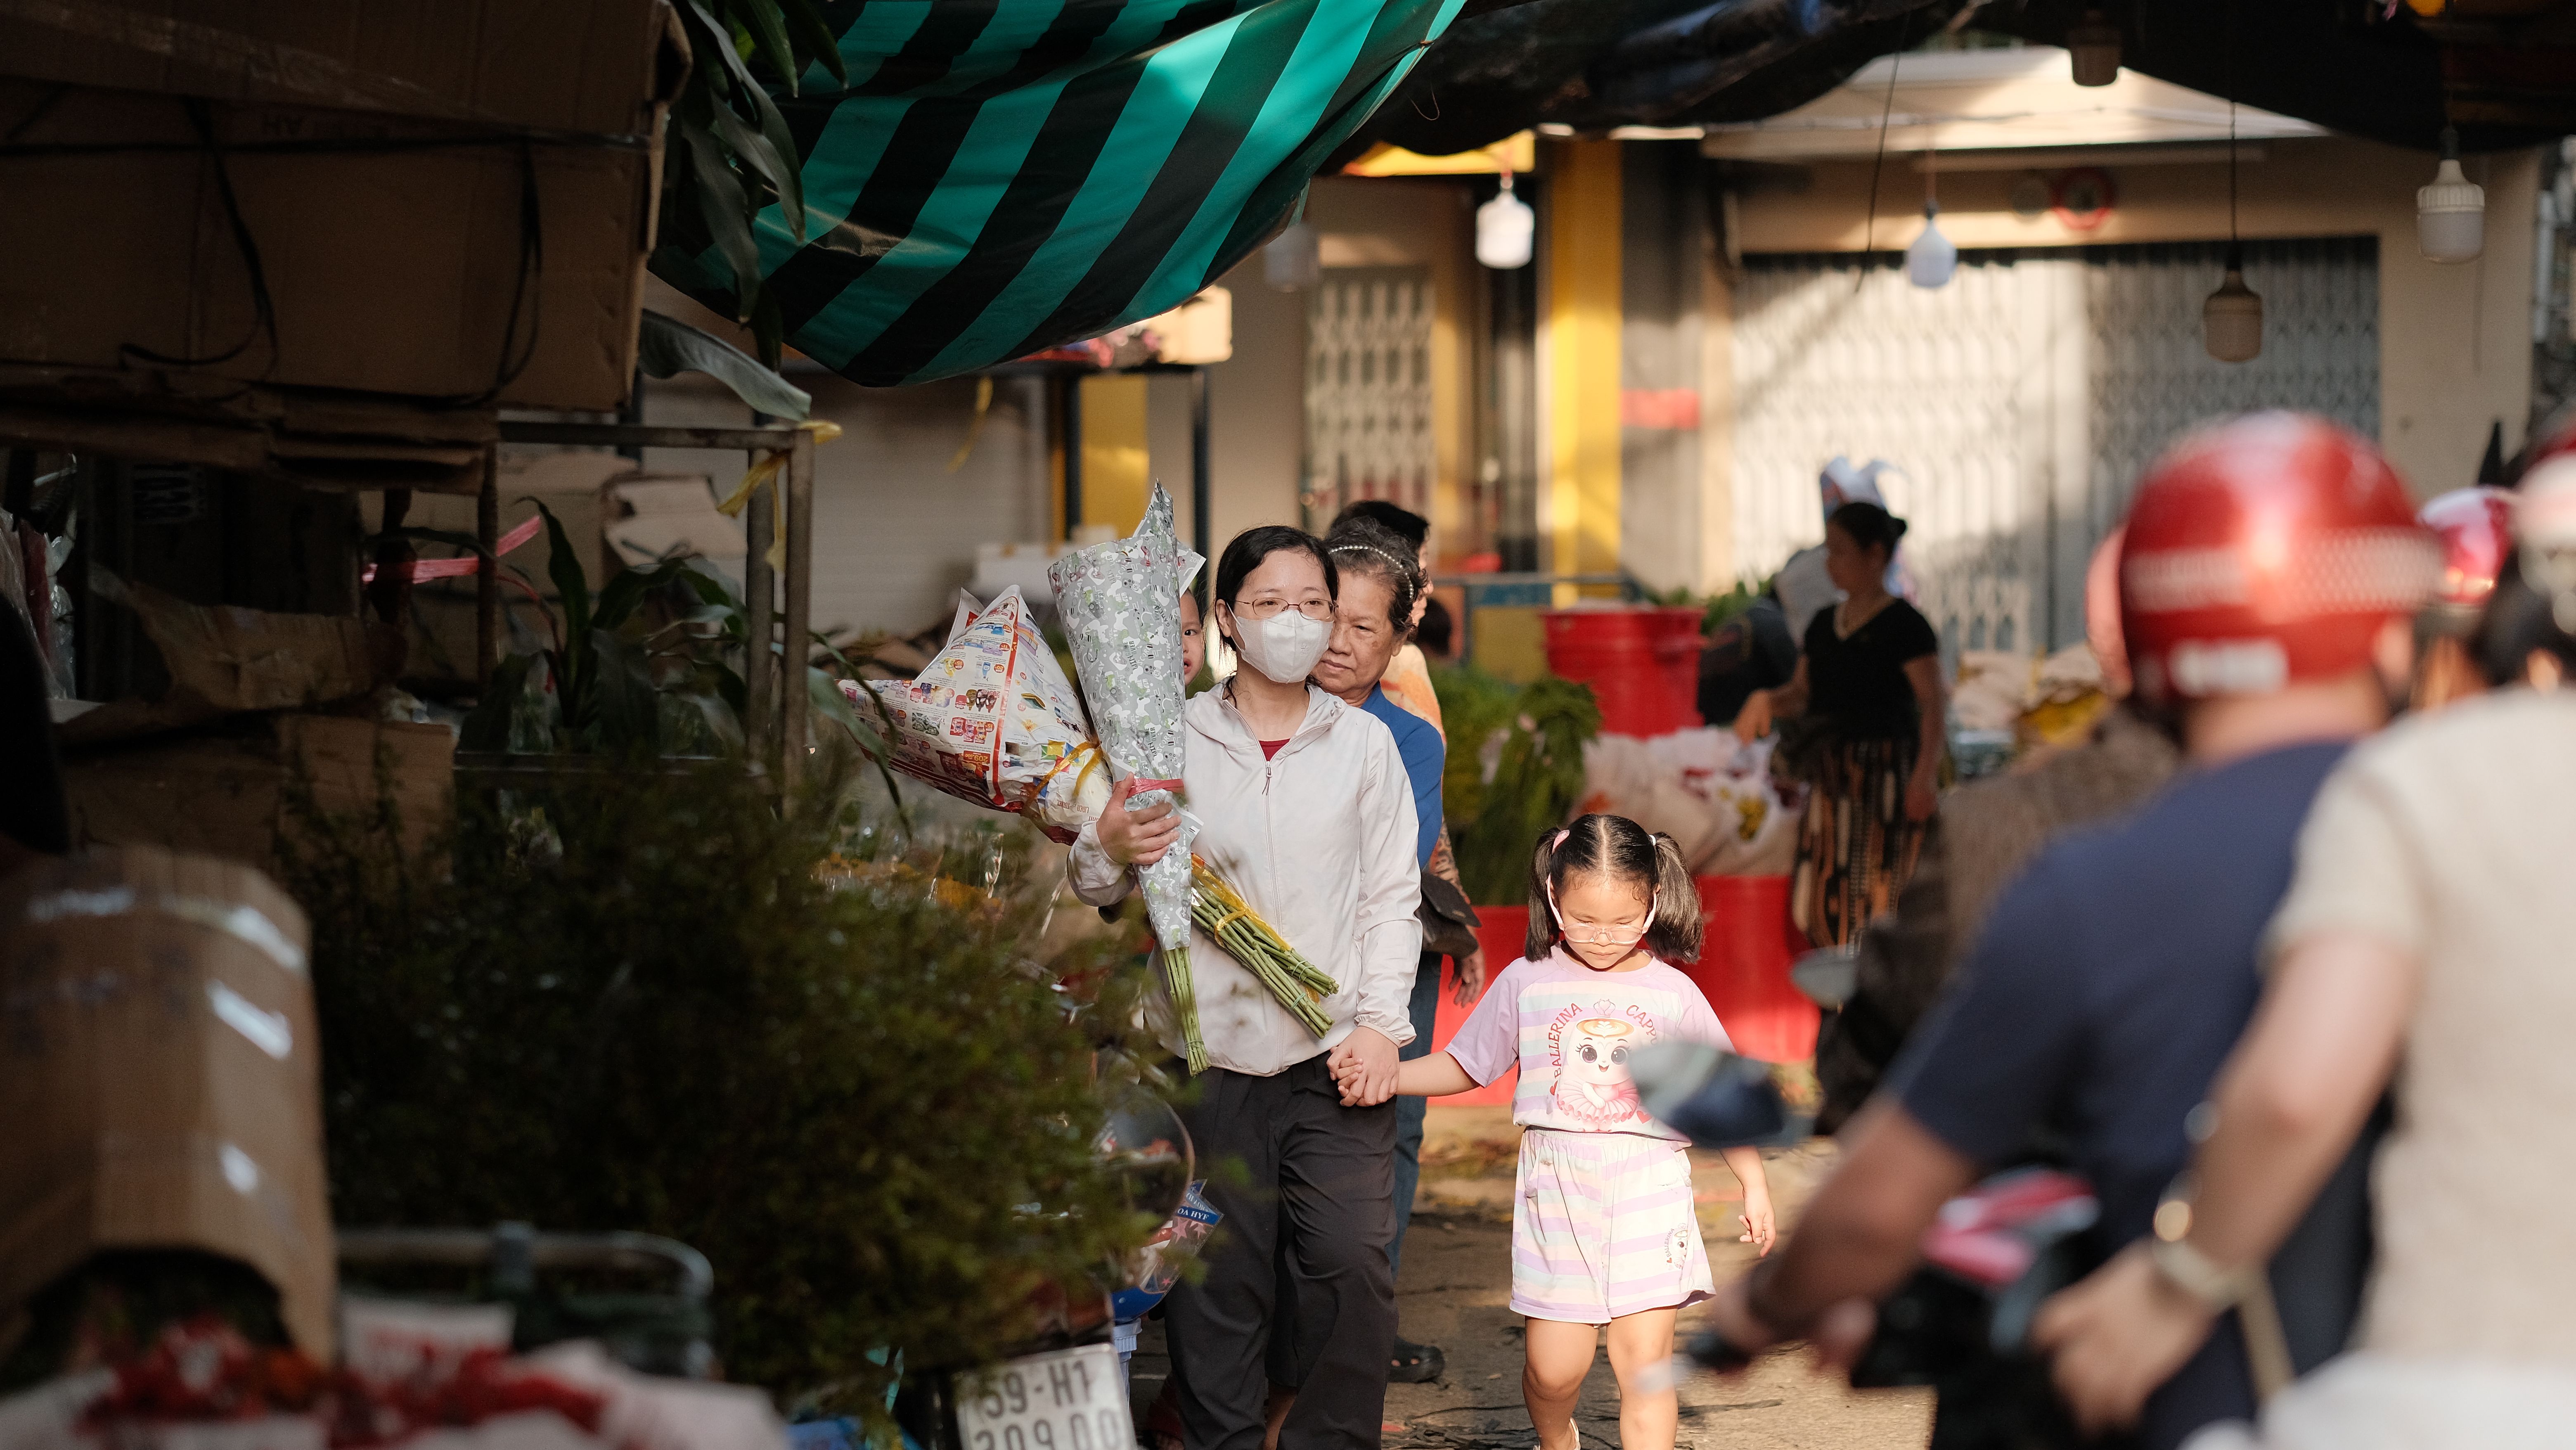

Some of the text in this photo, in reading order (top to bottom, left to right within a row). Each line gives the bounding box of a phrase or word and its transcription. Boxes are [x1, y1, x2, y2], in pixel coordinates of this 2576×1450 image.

[1155, 604, 1170, 627] GAMER
[1127, 655, 1138, 670] WIN
[1148, 742, 1158, 756] WIN
[1158, 914, 1170, 935] PLAY
[1548, 1003, 1583, 1079] BALLERINA
[1664, 1228, 1674, 1258] BALLERINA
